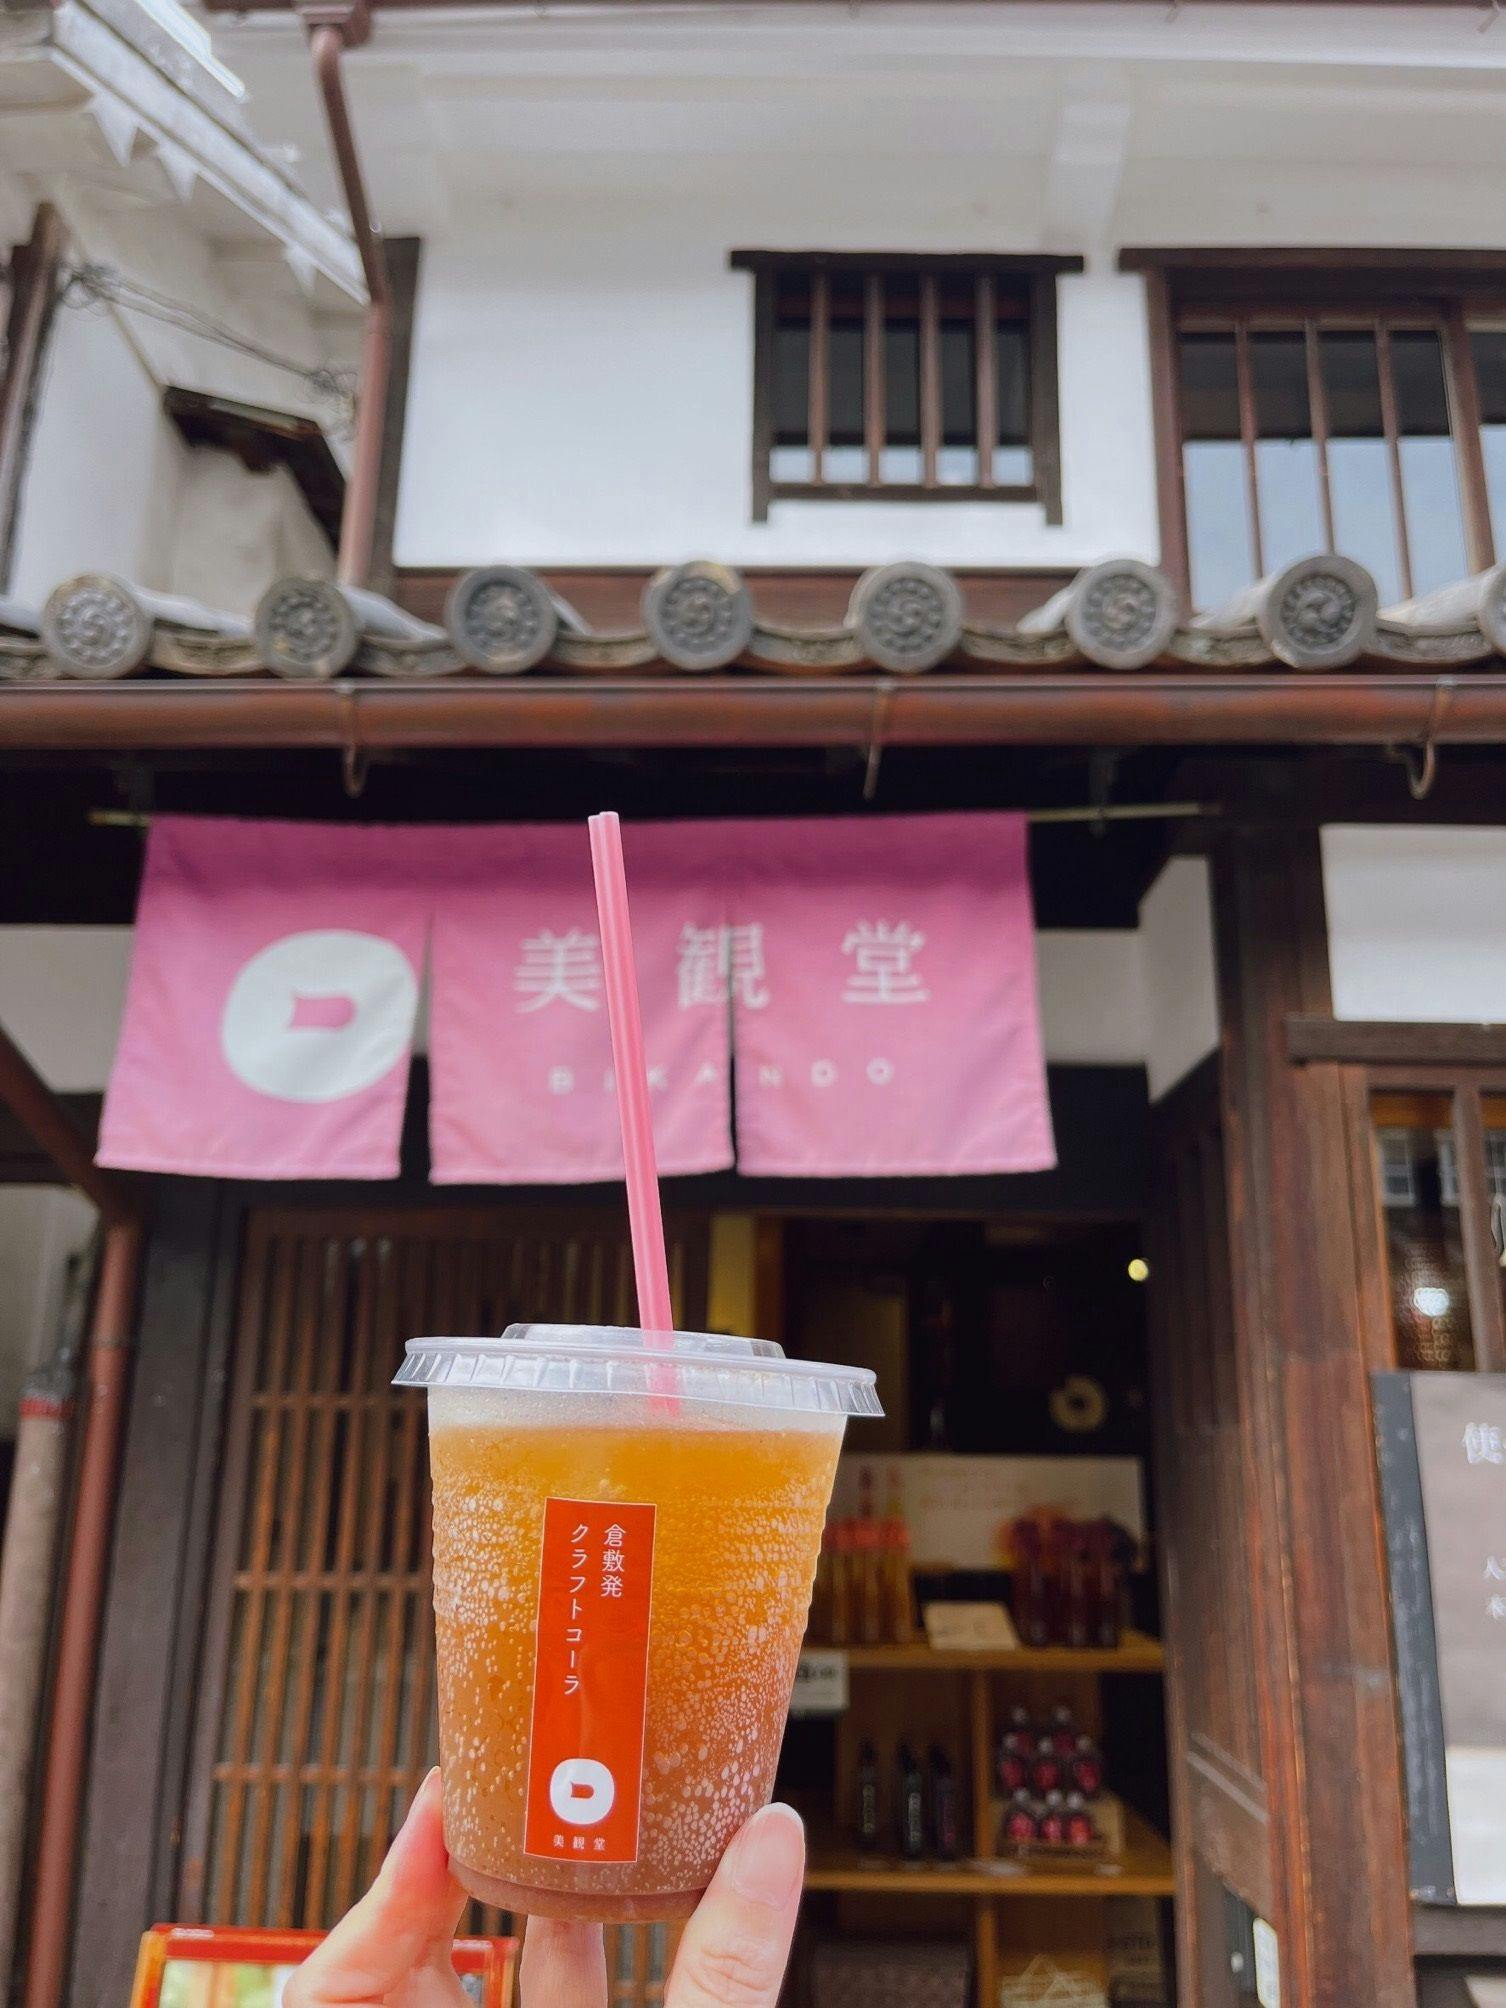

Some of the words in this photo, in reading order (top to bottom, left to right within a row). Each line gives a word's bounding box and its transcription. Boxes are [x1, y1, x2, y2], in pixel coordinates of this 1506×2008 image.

[514, 920, 930, 1014] 美観堂
[600, 1523, 626, 1597] 倉敷発
[563, 1523, 589, 1696] クラフトコーラ
